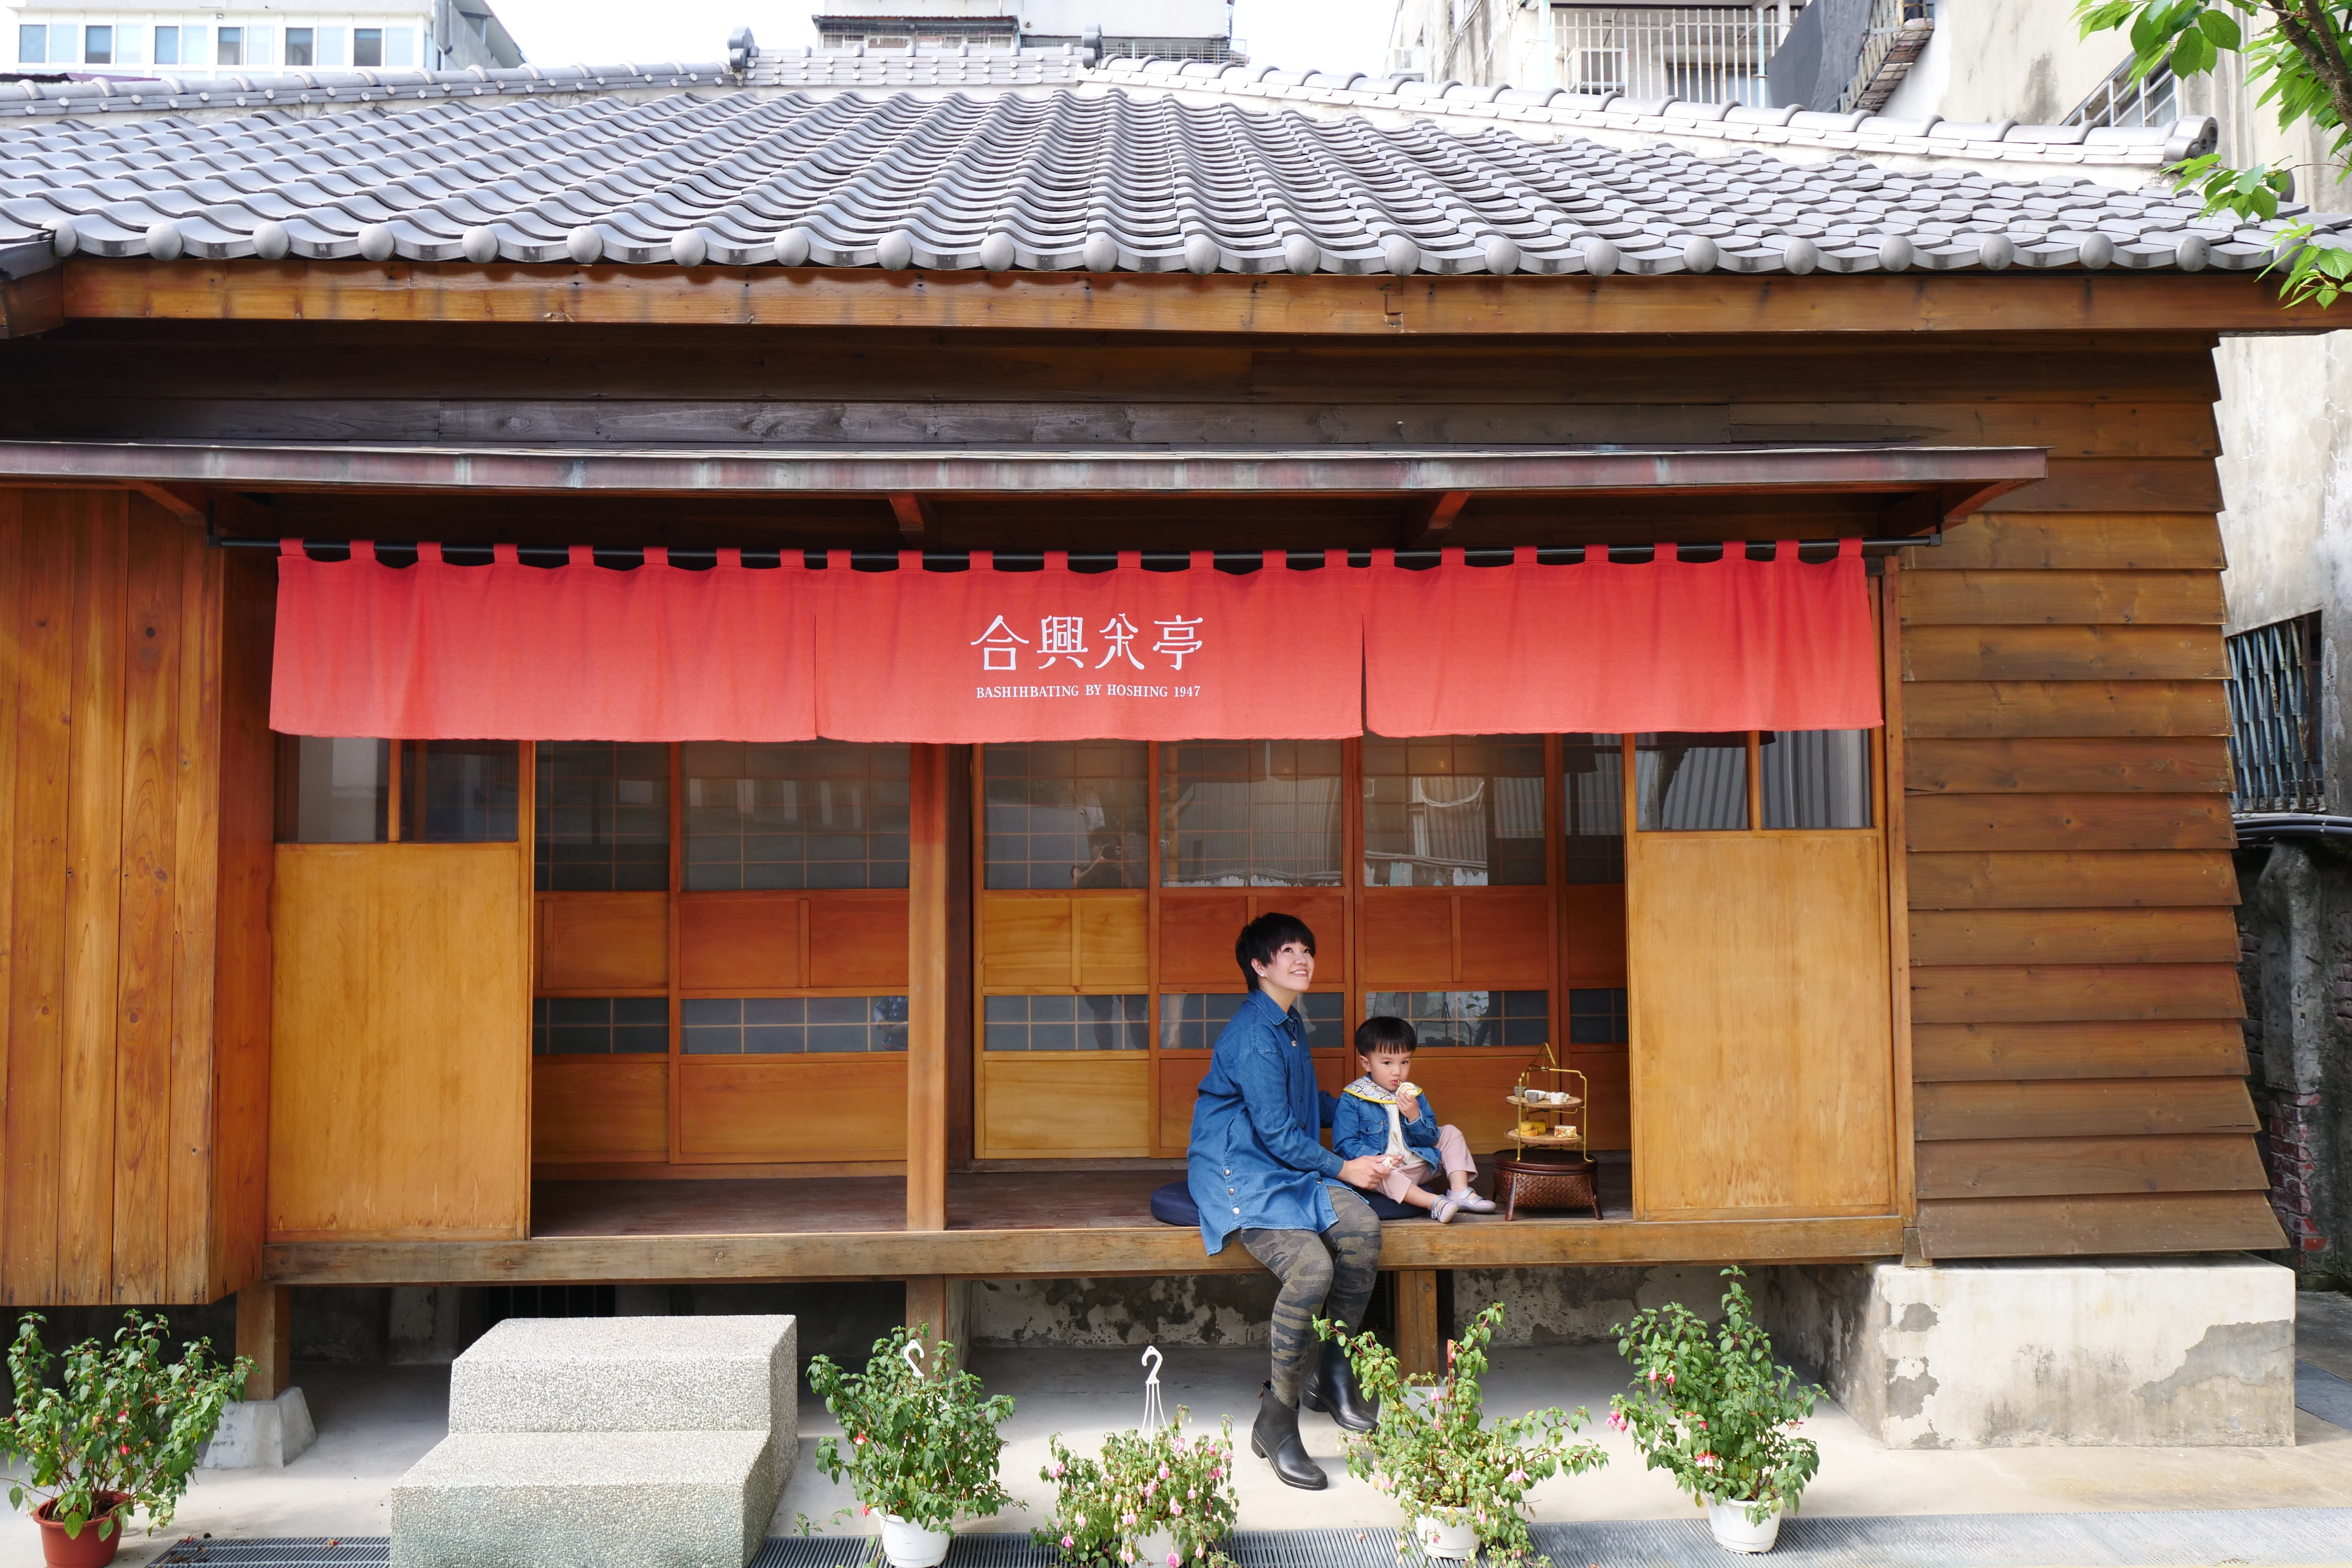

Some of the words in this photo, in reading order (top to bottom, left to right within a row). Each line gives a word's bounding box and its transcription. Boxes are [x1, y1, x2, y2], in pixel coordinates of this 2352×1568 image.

[976, 685, 1079, 698] BASHIHBATING
[1085, 684, 1102, 696] BY
[1107, 684, 1168, 697] HOSHING
[1174, 686, 1200, 697] 1947
